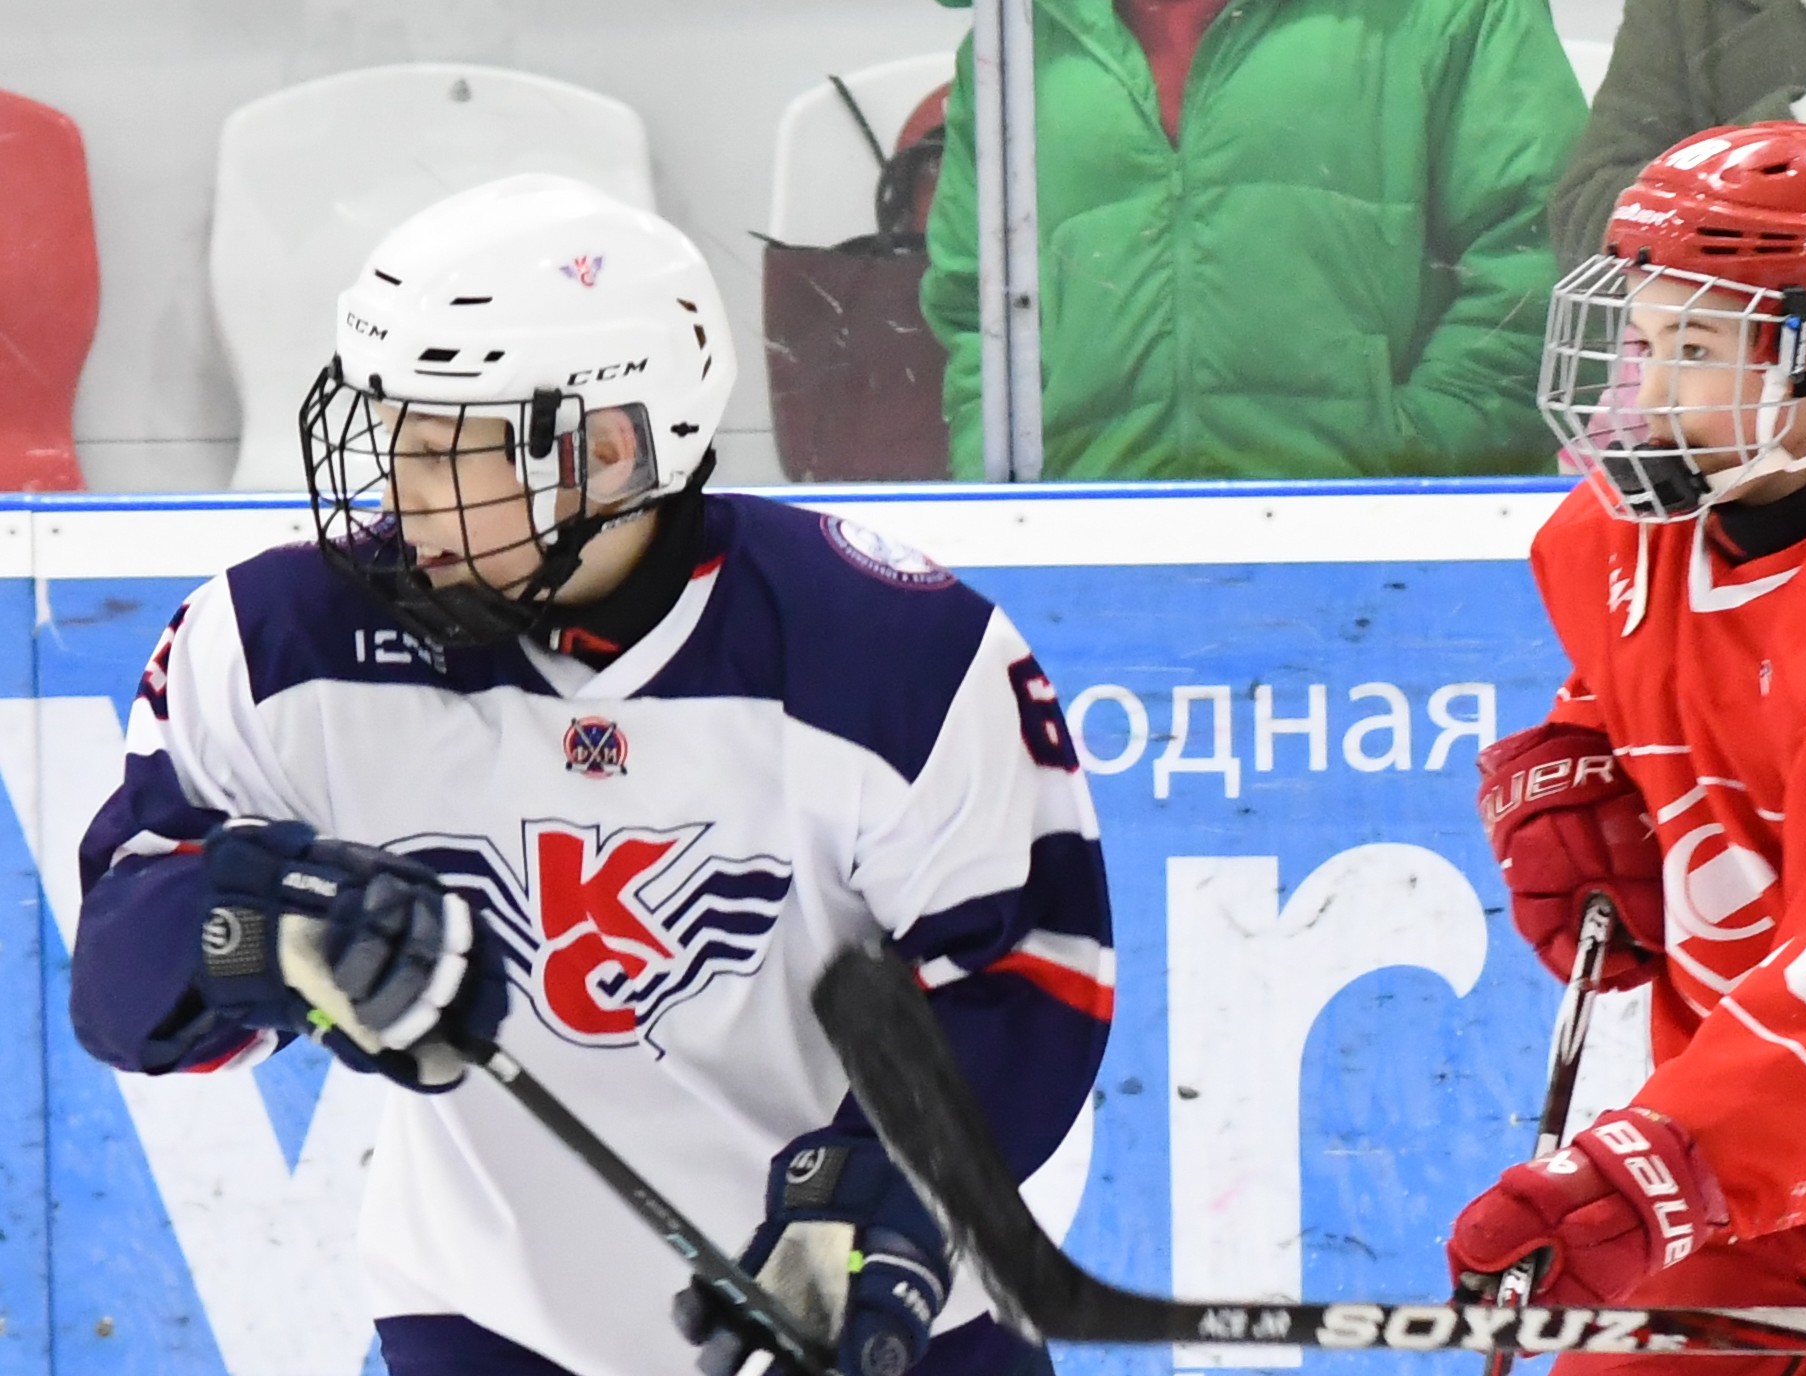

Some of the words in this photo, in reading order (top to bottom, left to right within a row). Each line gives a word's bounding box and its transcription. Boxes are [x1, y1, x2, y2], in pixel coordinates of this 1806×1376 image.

[346, 311, 389, 341] CCM
[566, 357, 650, 387] CCM
[1065, 682, 1498, 799] одная
[1591, 1118, 1695, 1270] BAUE
[1315, 1303, 1651, 1352] SOYUZ
